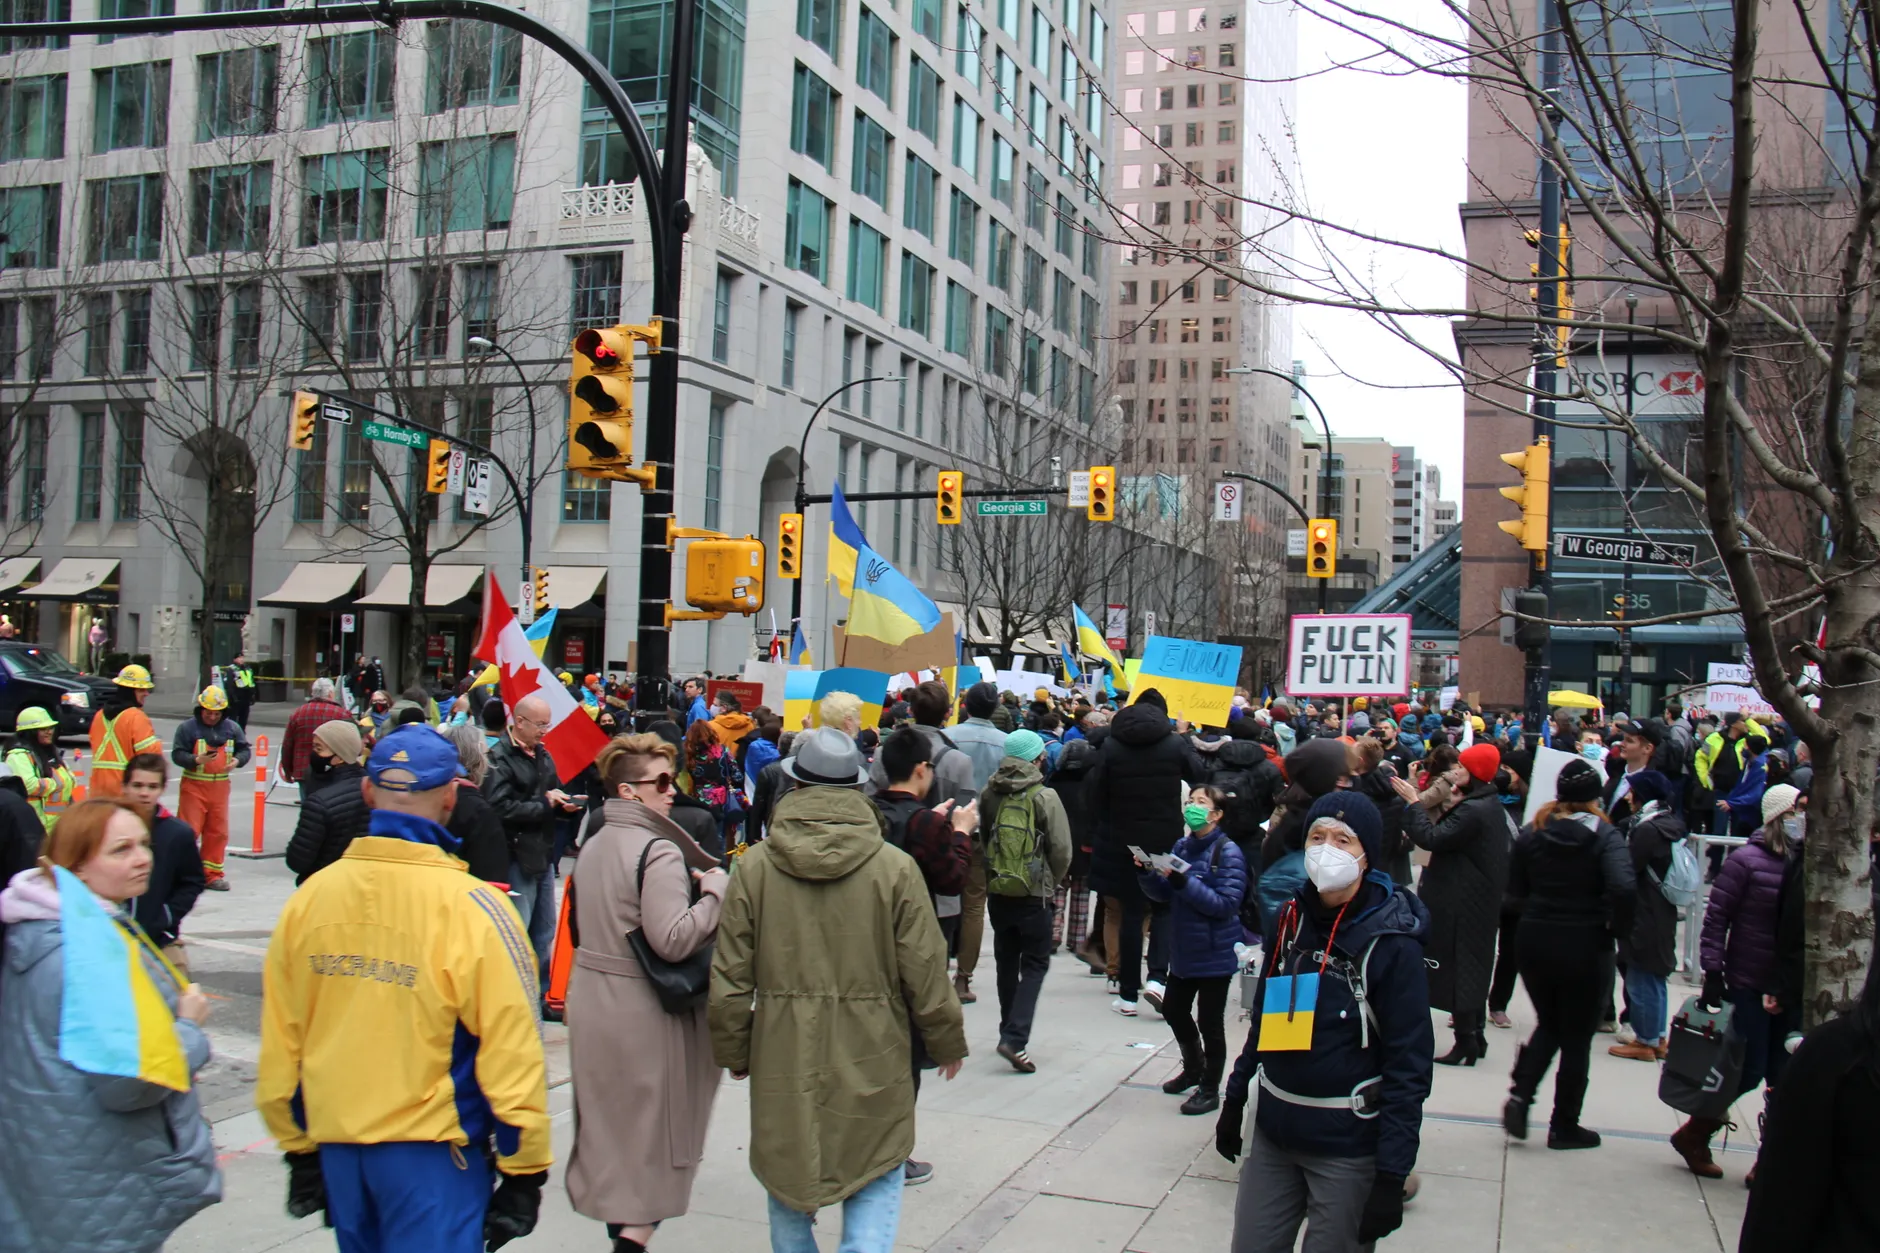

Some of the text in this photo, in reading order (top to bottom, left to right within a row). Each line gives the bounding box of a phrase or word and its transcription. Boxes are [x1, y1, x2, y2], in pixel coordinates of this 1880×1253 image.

[1566, 371, 1653, 396] HSBC
[384, 427, 421, 445] Hornby St
[982, 502, 1042, 513] Georgia St
[1568, 537, 1643, 561] W Georgia
[1649, 552, 1666, 560] 800
[1302, 625, 1396, 652] FUCK
[1299, 654, 1395, 684] PUTIN
[1710, 691, 1748, 703] ПУТИН
[308, 954, 419, 988] UKRAINE
